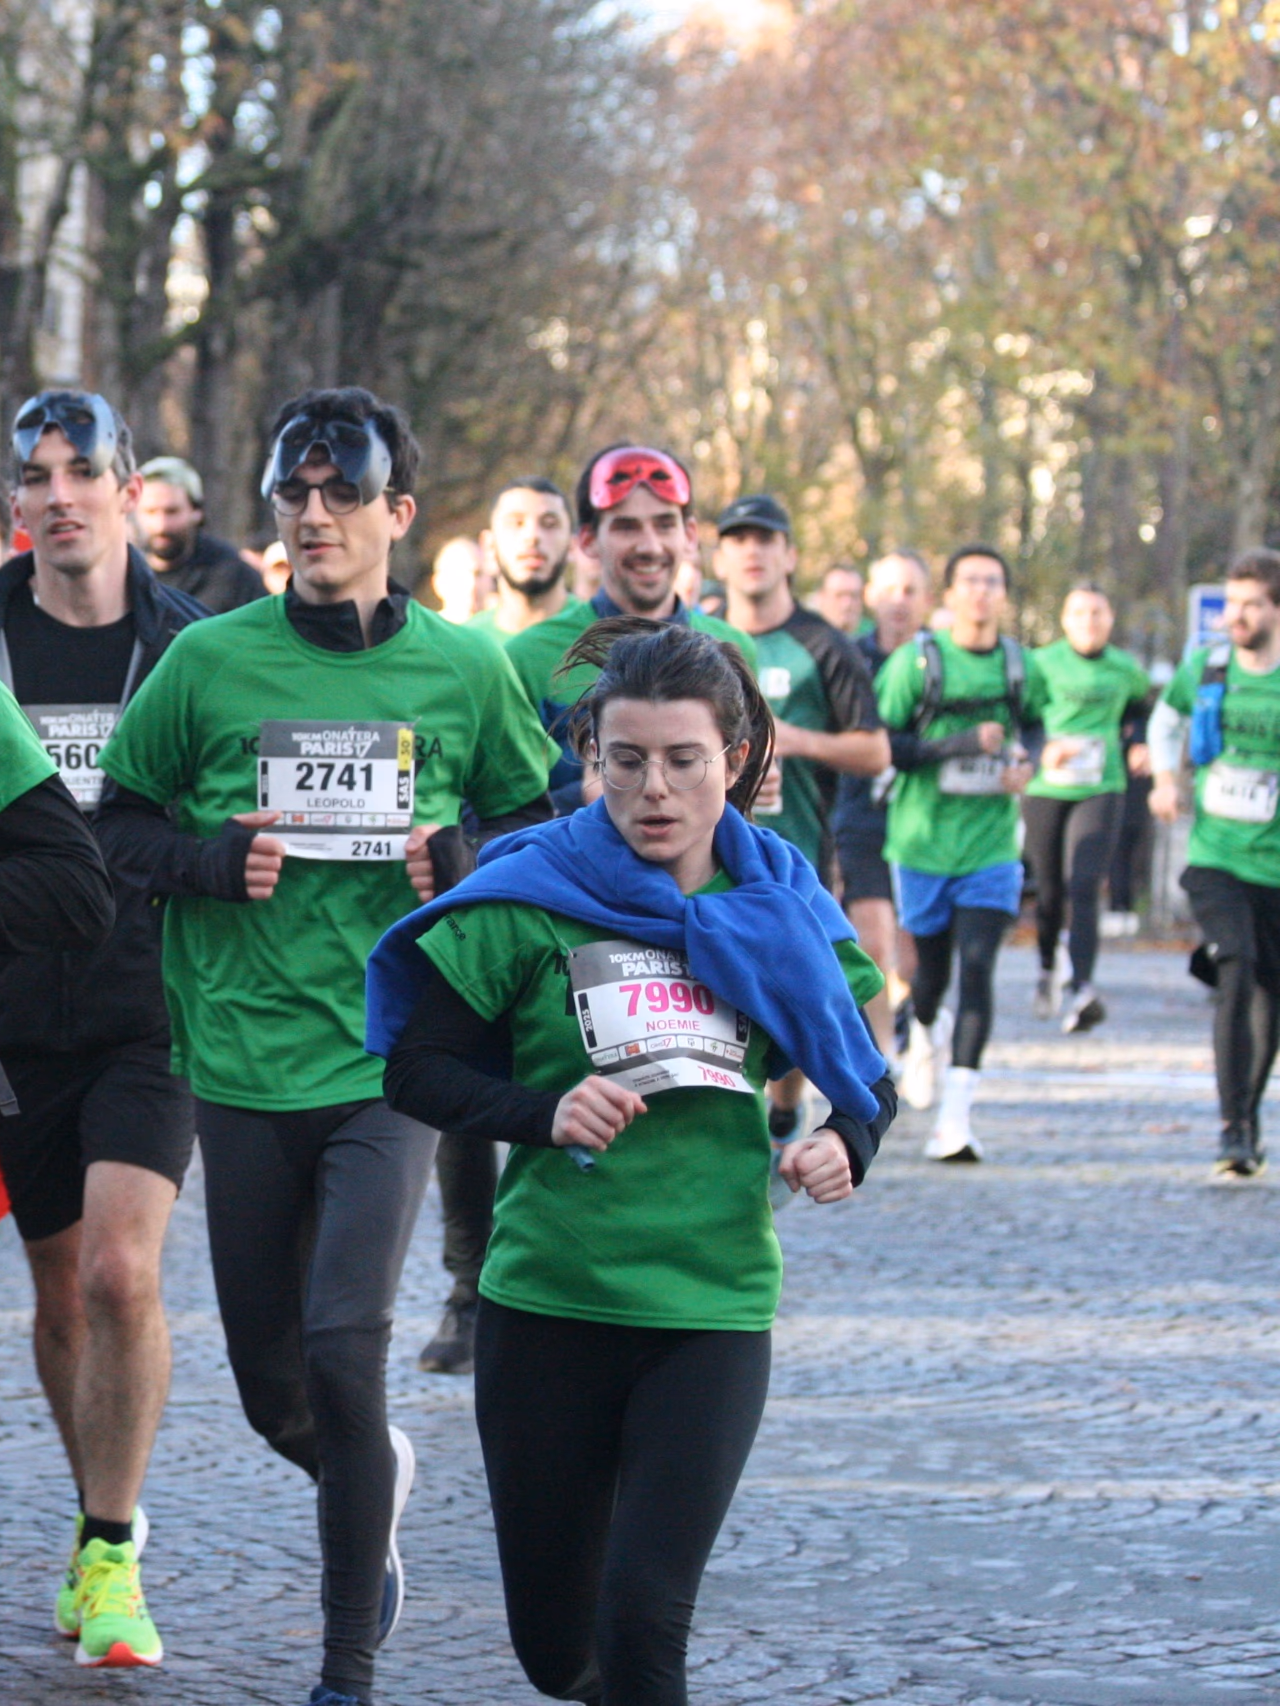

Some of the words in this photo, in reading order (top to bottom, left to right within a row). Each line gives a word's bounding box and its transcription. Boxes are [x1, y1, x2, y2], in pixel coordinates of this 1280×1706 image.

[295, 762, 374, 791] 2741
[399, 776, 410, 803] SAS
[306, 797, 366, 809] LEOPOLD
[351, 840, 392, 857] 2741
[619, 981, 715, 1017] 7990
[646, 1019, 701, 1032] NOEMIE
[698, 1065, 736, 1088] 7990
